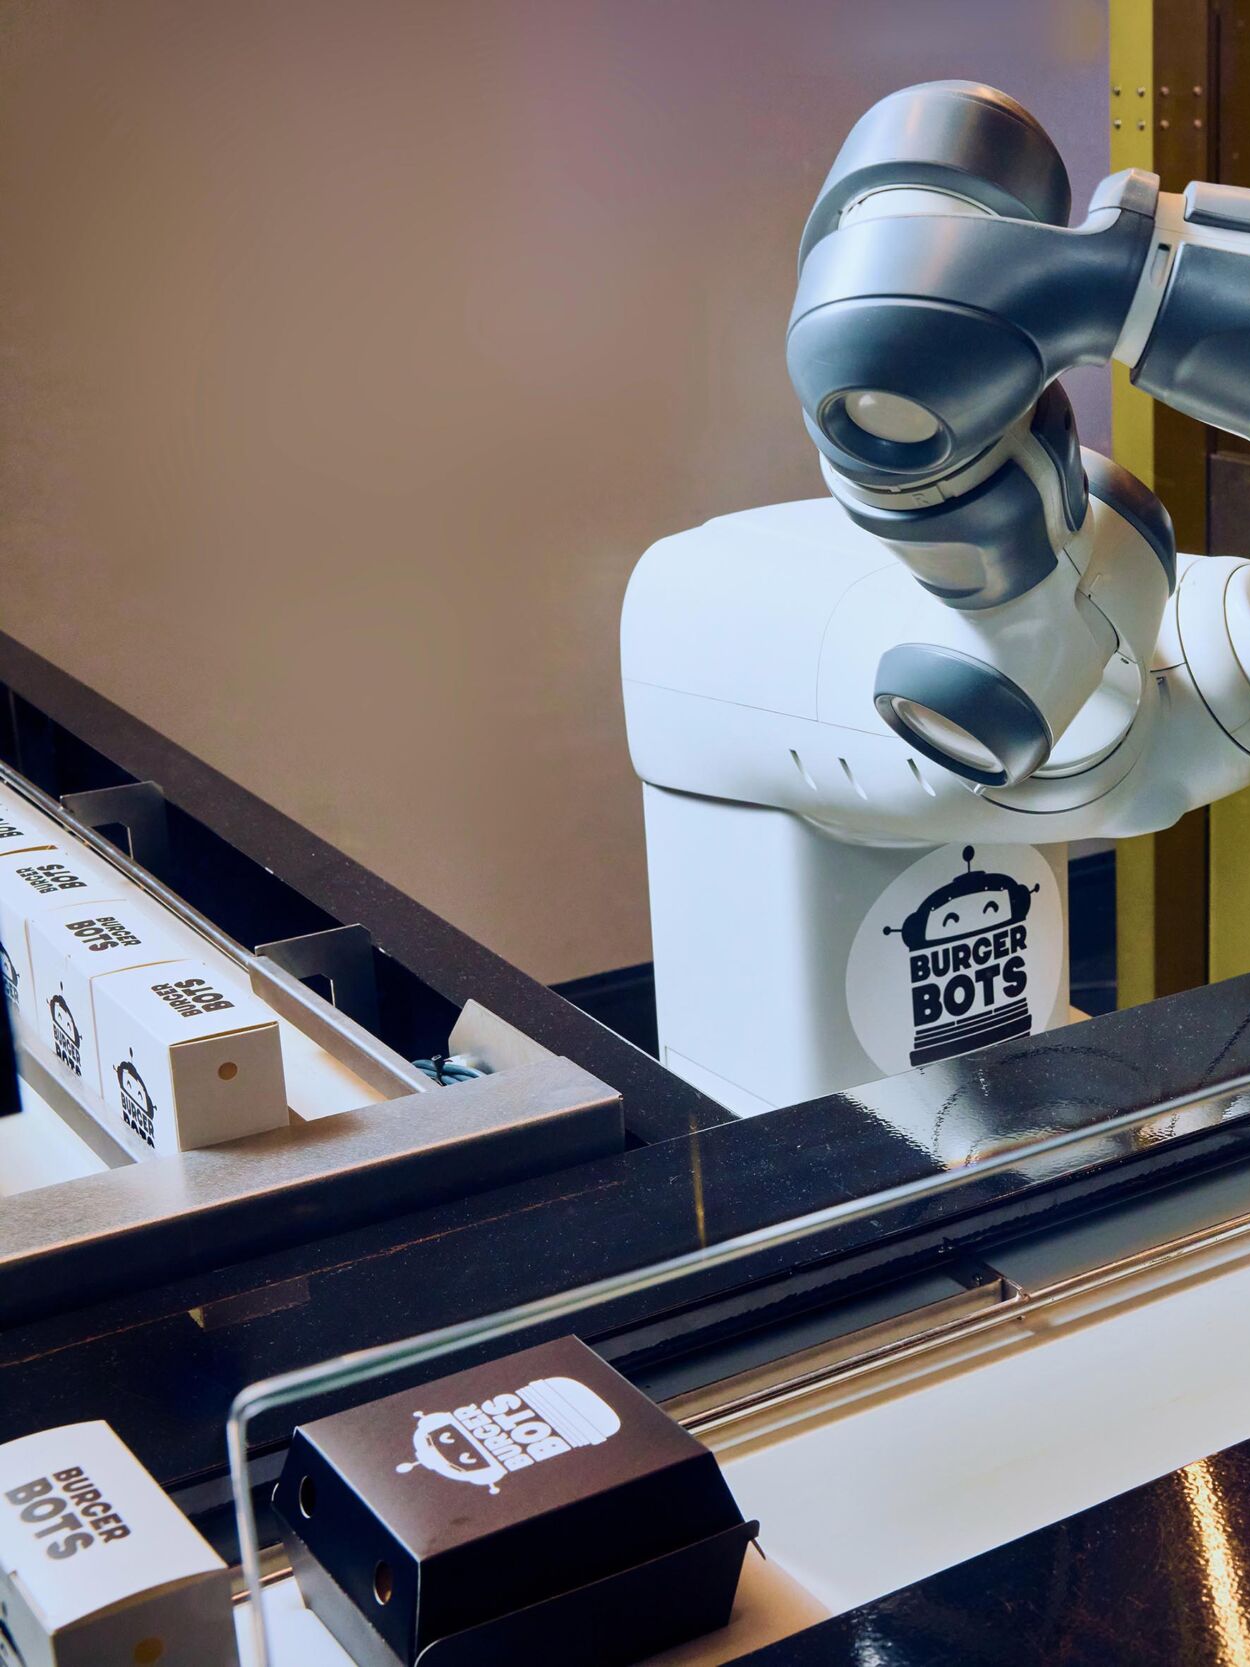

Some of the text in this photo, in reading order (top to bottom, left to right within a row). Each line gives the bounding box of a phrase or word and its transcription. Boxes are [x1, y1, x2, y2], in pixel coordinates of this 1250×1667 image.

[16, 866, 58, 893] BURGER
[37, 864, 87, 889] BOTS
[65, 920, 119, 951] BOTS
[96, 917, 141, 946] BURGER
[910, 925, 1027, 983] BURGER
[151, 983, 203, 1017] BURGER
[174, 979, 235, 1012] BOTS
[911, 956, 1027, 1027] BOTS
[121, 1091, 154, 1139] BURGER
[453, 1403, 535, 1472] BURGER
[481, 1393, 572, 1472] BOTS
[5, 1477, 94, 1560] BOTS
[53, 1466, 131, 1543] BURGER
